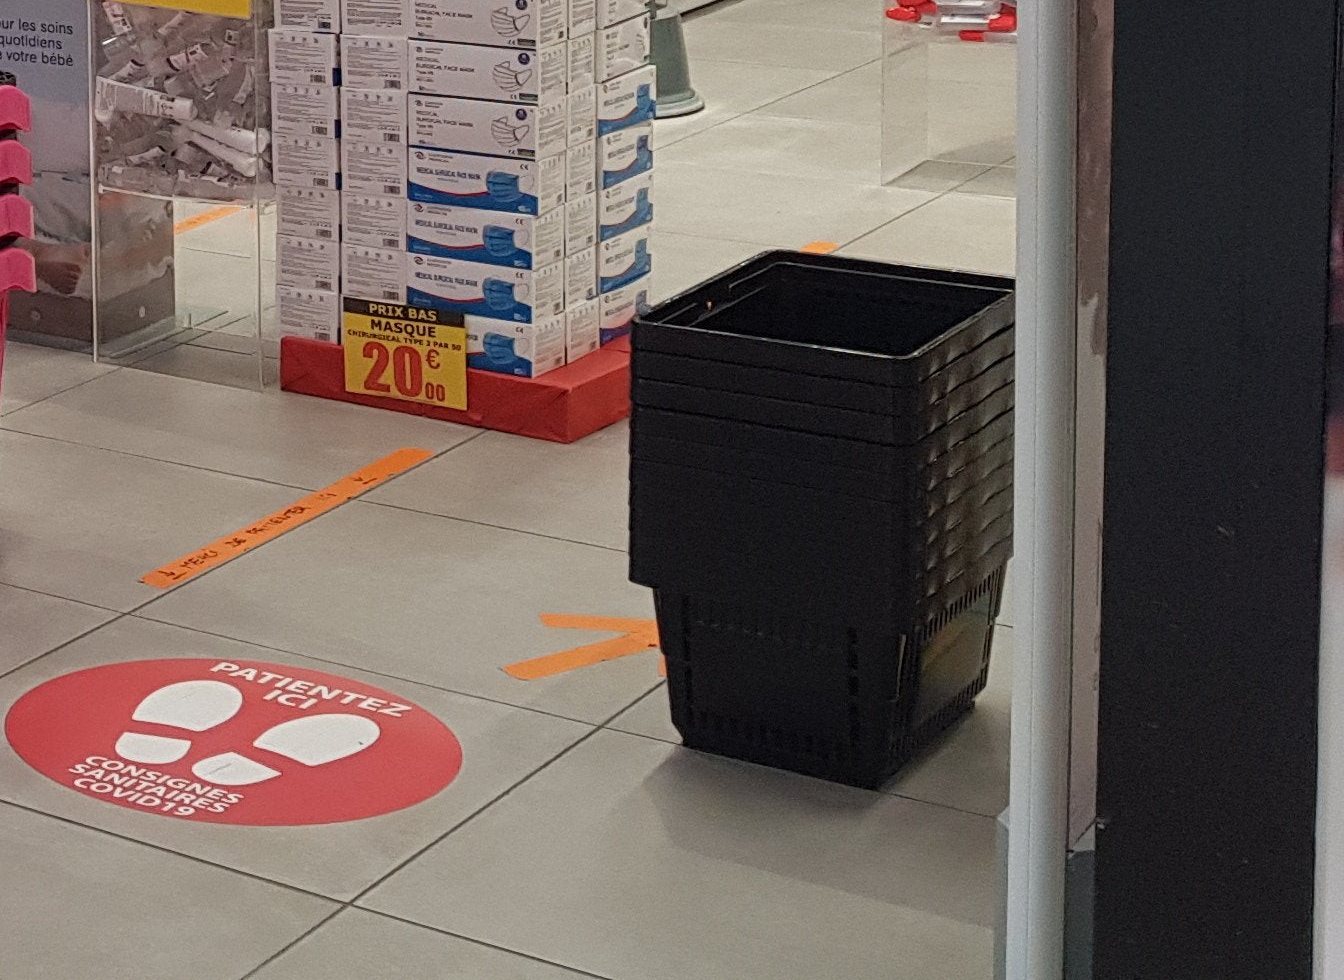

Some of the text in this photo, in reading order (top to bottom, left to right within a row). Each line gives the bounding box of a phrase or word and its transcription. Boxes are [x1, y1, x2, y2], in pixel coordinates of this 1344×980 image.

[18, 17, 36, 32] les
[40, 21, 74, 36] soins
[5, 48, 38, 64] votre
[40, 50, 74, 67] bébé
[369, 303, 437, 321] PRIX BAS
[370, 319, 436, 338] MASQUE
[404, 337, 424, 346] TYPE
[433, 341, 449, 349] PAR
[363, 340, 446, 402] 20 € 00
[210, 661, 412, 718] PATIENTEZ
[264, 690, 317, 709] ICI
[68, 764, 230, 814] SANITAIRES
[84, 756, 244, 804] CONSIGNES
[73, 778, 196, 817] COVID19
